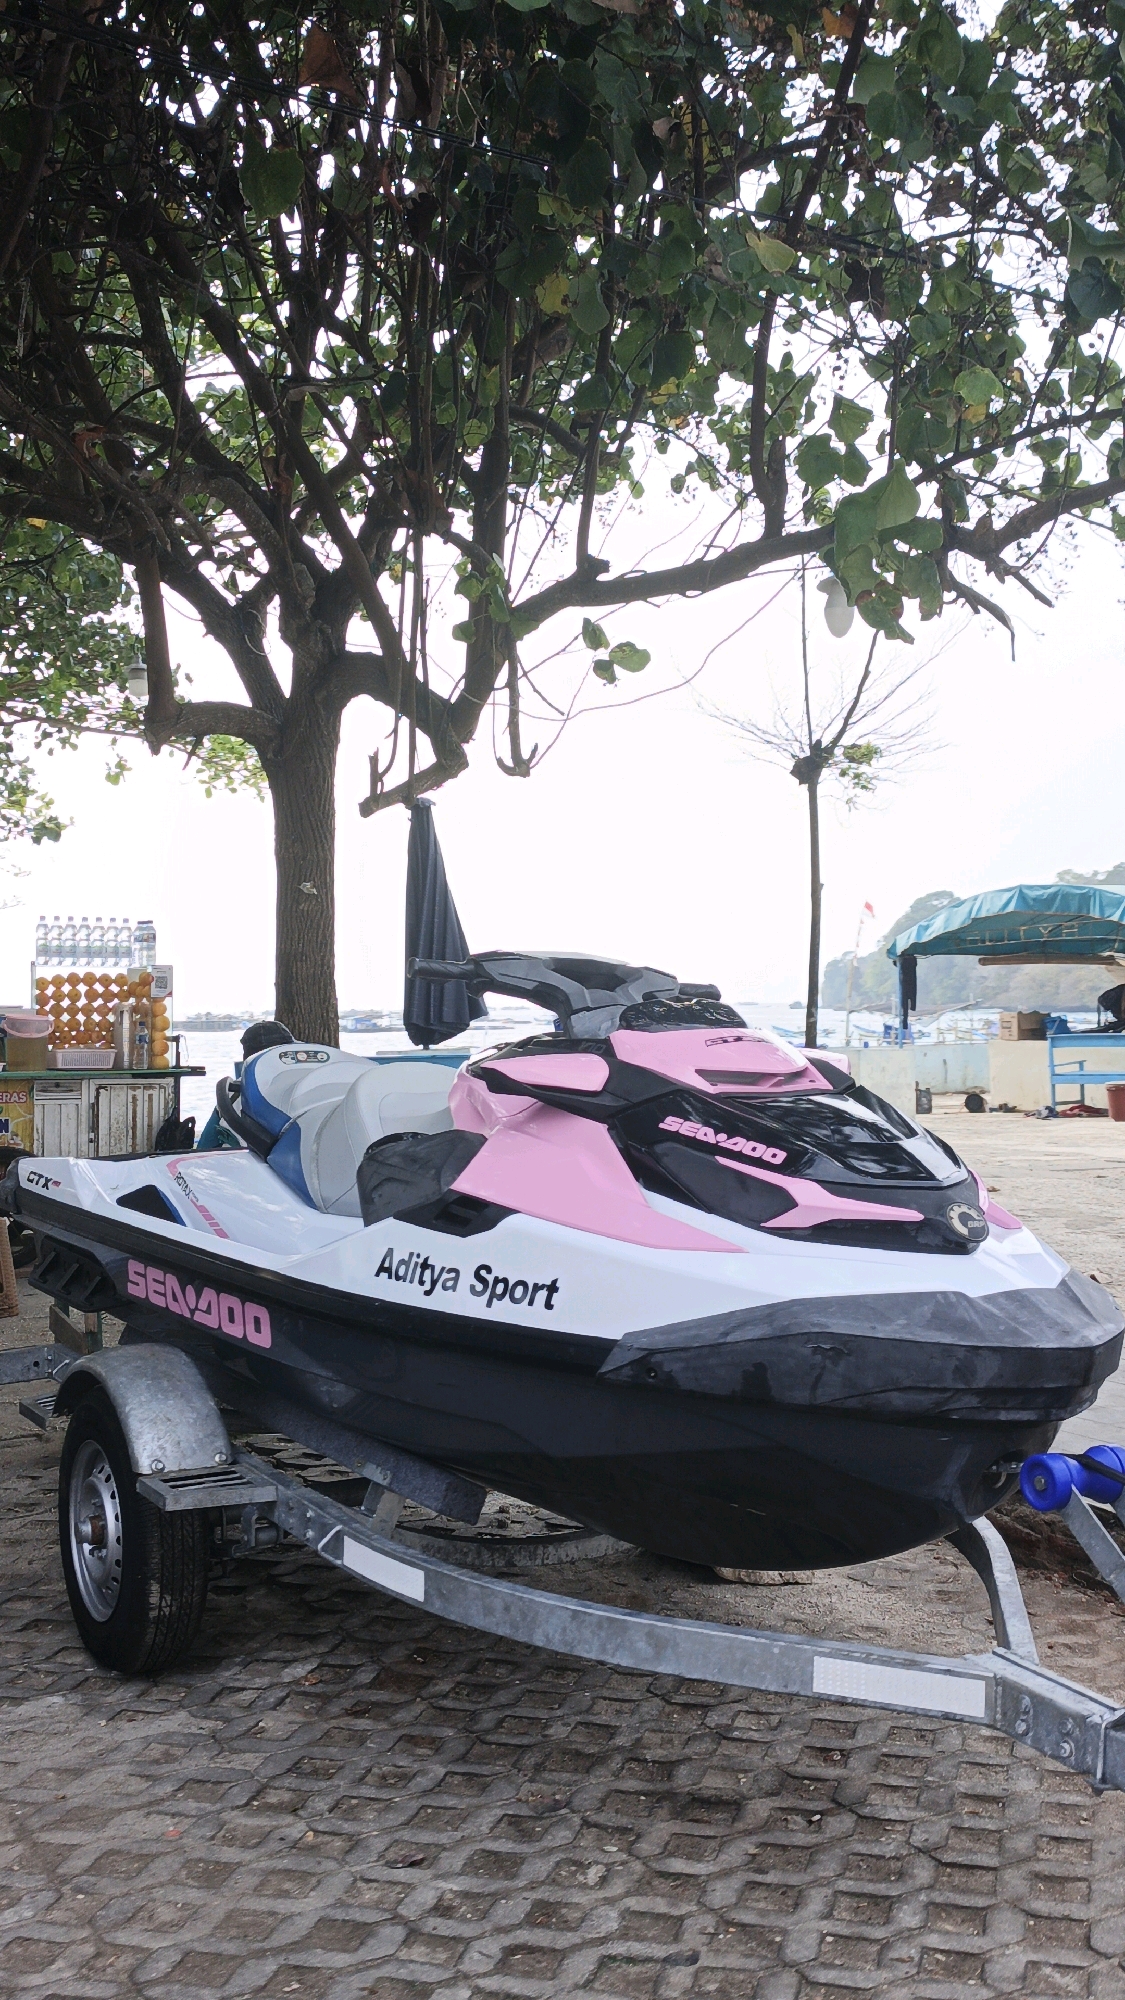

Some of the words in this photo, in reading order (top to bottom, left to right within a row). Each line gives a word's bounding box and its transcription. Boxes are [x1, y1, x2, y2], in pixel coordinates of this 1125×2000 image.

[27, 1171, 53, 1190] GTX
[173, 1171, 193, 1200] ROTAX
[374, 1247, 461, 1296] Aditya
[469, 1263, 560, 1311] Sport
